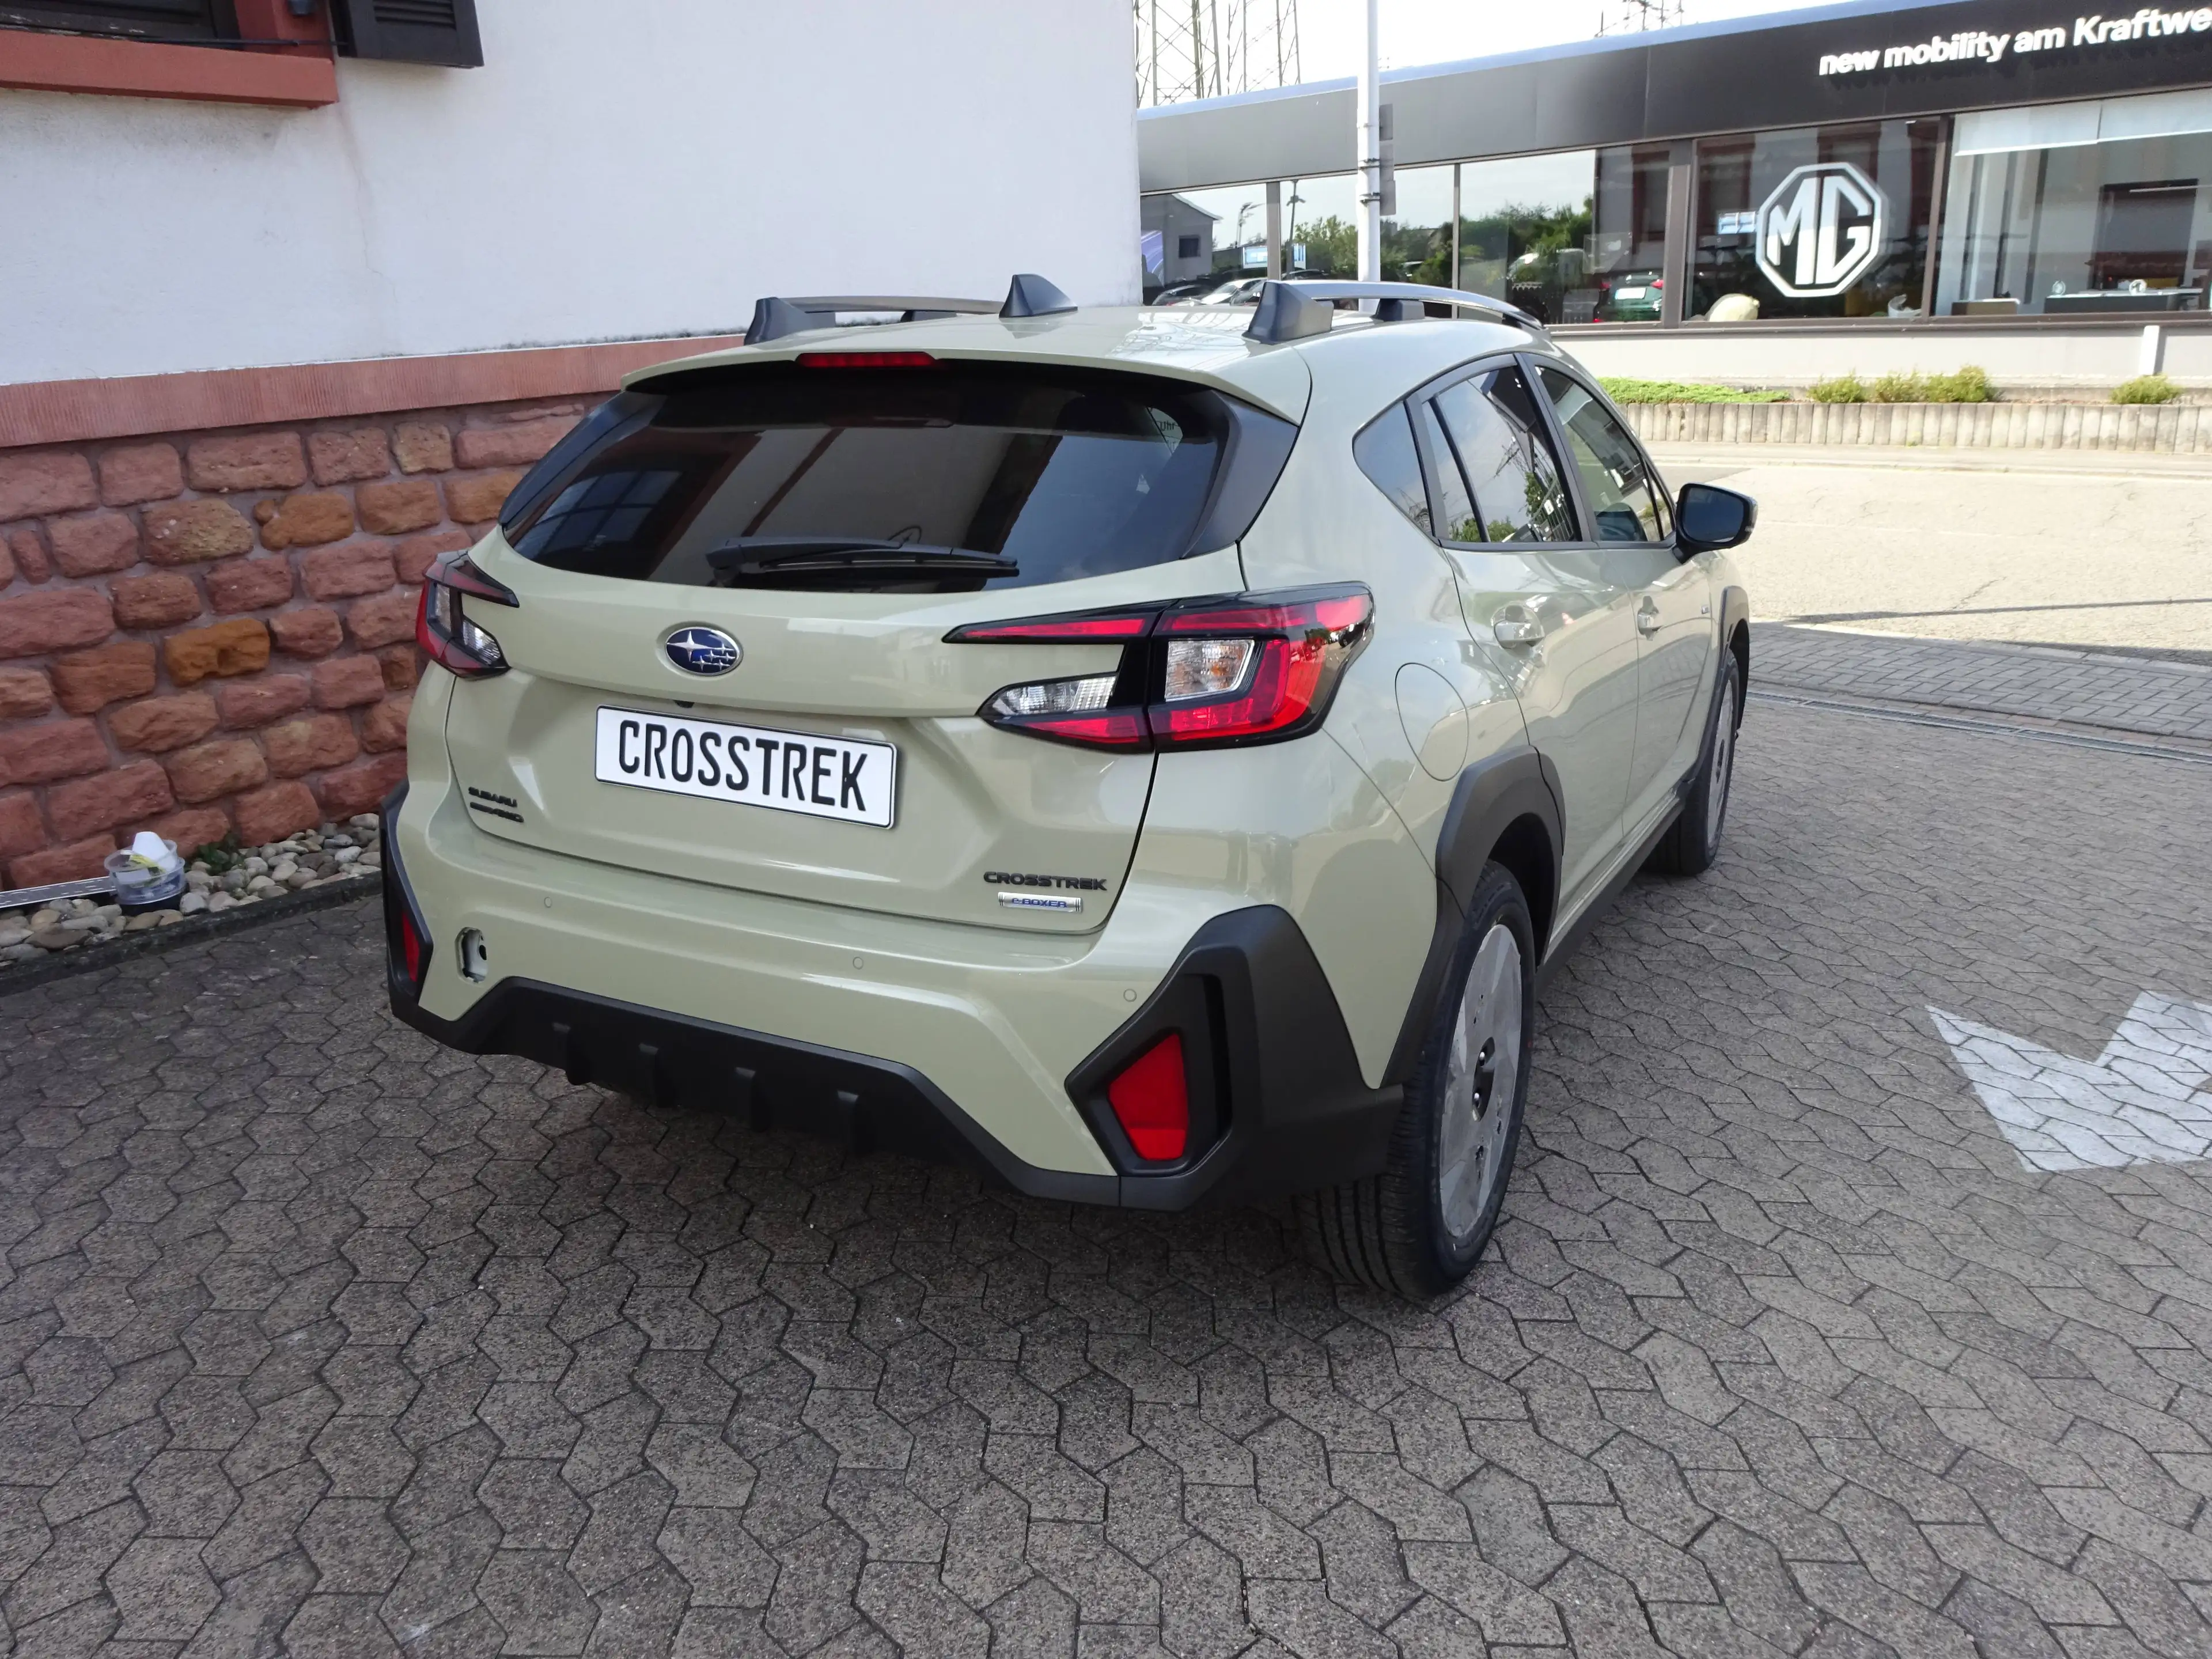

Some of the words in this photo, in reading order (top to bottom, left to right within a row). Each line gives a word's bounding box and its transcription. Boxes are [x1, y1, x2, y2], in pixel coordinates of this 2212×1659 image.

[1819, 50, 1880, 76] new
[1883, 31, 2010, 68] mobility
[2013, 26, 2066, 54] am
[2072, 6, 2212, 47] Kraftwe
[1766, 175, 1872, 285] MG
[619, 719, 868, 811] CROSSTREK
[983, 871, 1107, 891] CROSSTREK
[1012, 897, 1067, 908] e-BOXER
